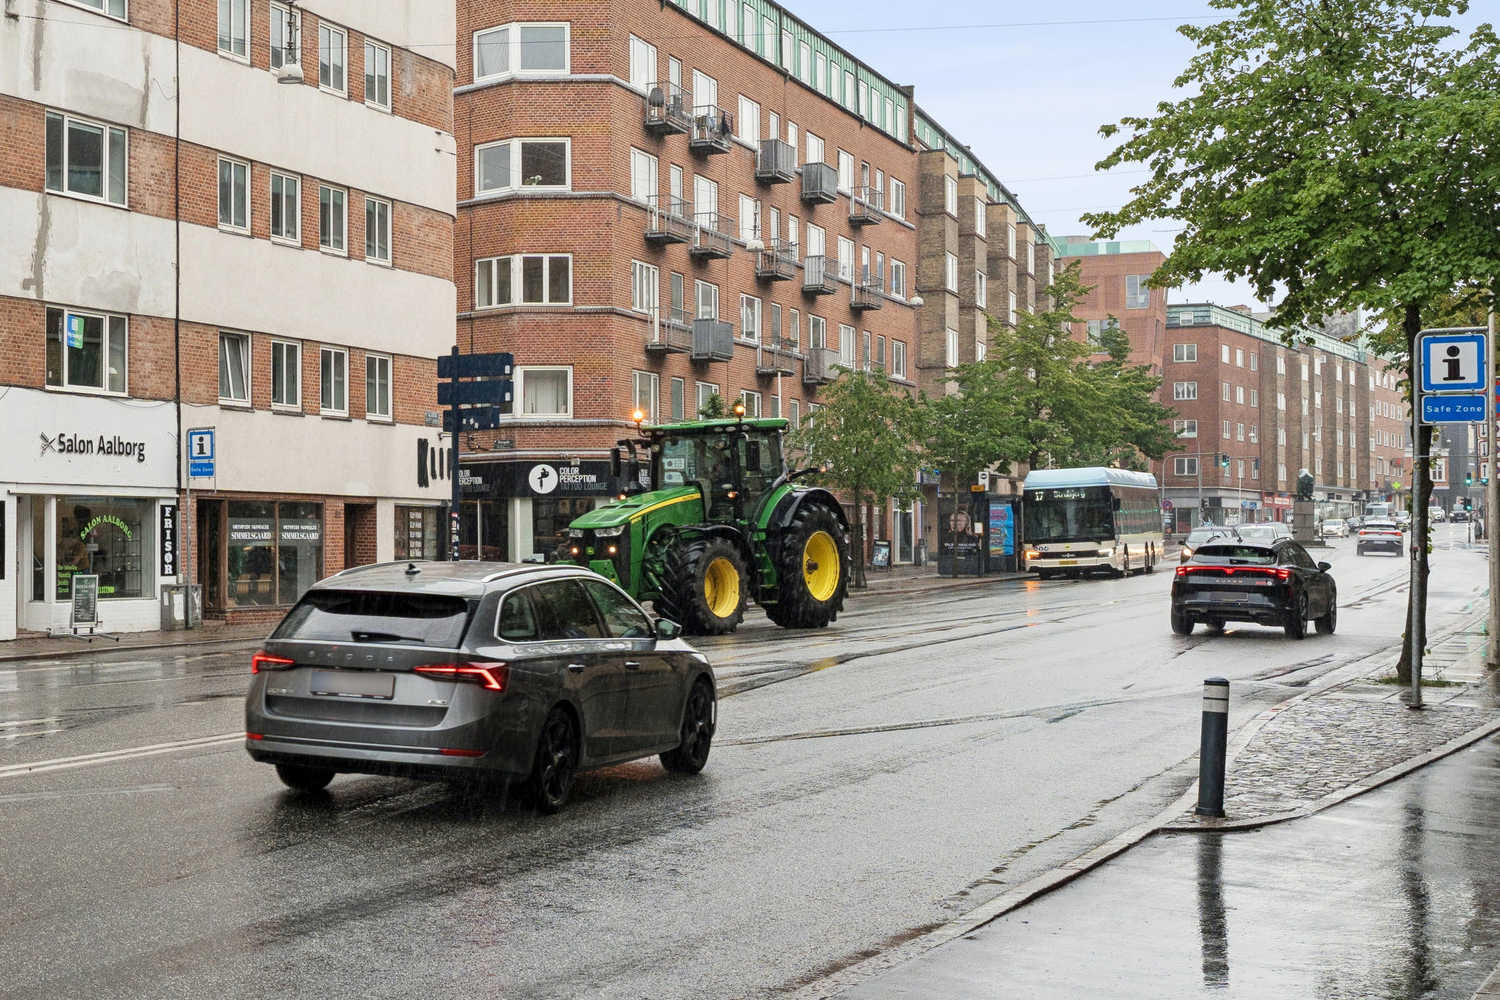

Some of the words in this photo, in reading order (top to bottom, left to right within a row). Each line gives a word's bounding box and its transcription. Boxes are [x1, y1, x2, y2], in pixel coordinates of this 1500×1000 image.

[1426, 405, 1451, 413] Safe
[1456, 405, 1482, 413] Zone
[58, 433, 93, 454] Salon
[97, 435, 145, 463] Aalborg
[559, 467, 579, 475] COLOR
[458, 477, 482, 485] ERCEPTION
[560, 482, 582, 490] TATTOO
[584, 482, 608, 490] LOUNGE
[1035, 492, 1044, 500] 17
[80, 515, 101, 540] SALON
[103, 515, 133, 538] AALBORG
[164, 507, 172, 574] FRISØR
